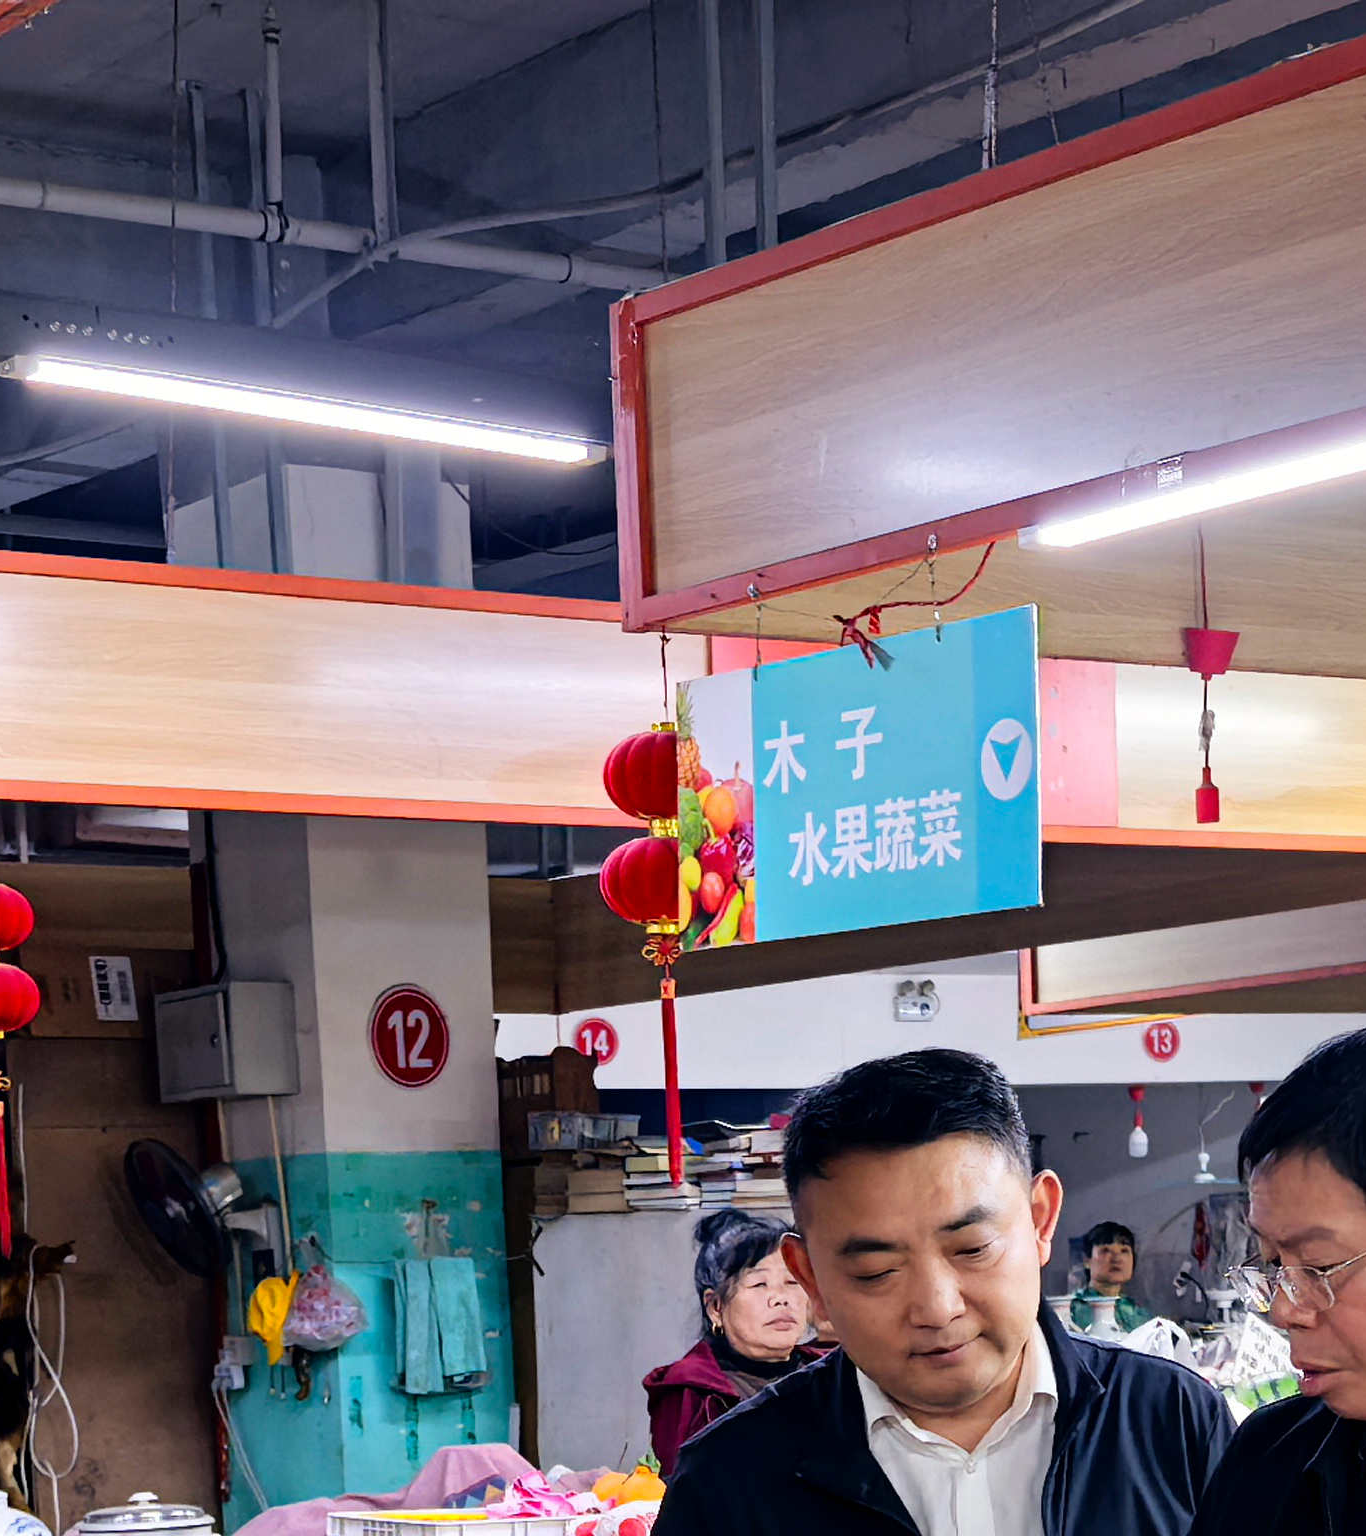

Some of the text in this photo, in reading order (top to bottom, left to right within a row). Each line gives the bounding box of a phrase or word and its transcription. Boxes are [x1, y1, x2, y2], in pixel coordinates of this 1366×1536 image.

[762, 706, 884, 794] 木子
[788, 788, 963, 887] 水果蔬菜
[387, 1009, 433, 1069] 12
[581, 1029, 609, 1057] 14
[1149, 1027, 1173, 1055] 13
